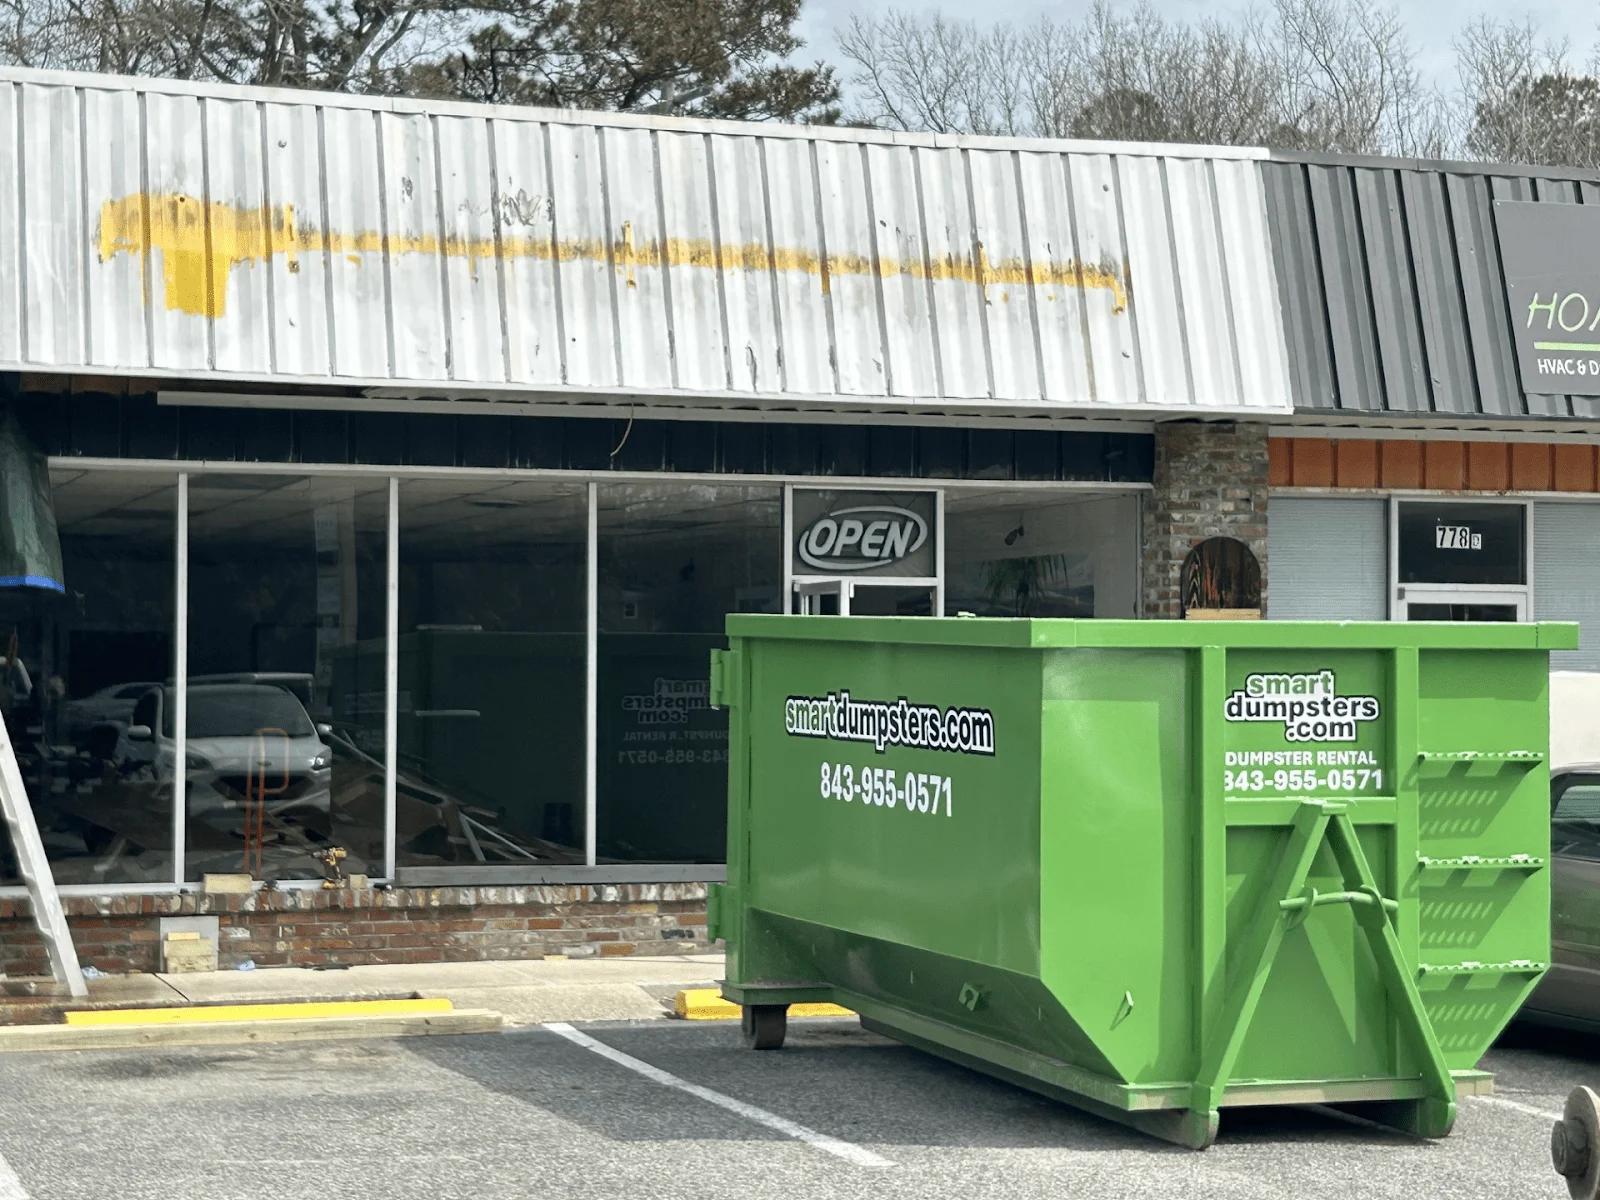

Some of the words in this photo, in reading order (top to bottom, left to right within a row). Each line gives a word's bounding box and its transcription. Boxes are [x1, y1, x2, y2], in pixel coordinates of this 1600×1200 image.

[1526, 291, 1600, 332] HO
[1537, 358, 1575, 375] HVAC
[1576, 358, 1587, 376] &
[1588, 358, 1600, 376] D
[807, 518, 915, 558] OPEN
[1437, 526, 1469, 548] 778
[1248, 672, 1332, 695] smart
[1226, 695, 1377, 722] dumpsters
[786, 693, 994, 753] smartdumpsters.com
[1288, 719, 1354, 738] .com
[1225, 751, 1313, 766] DUMPSTER
[1317, 751, 1377, 766] RENTAL
[820, 761, 952, 817] 843-955-0571
